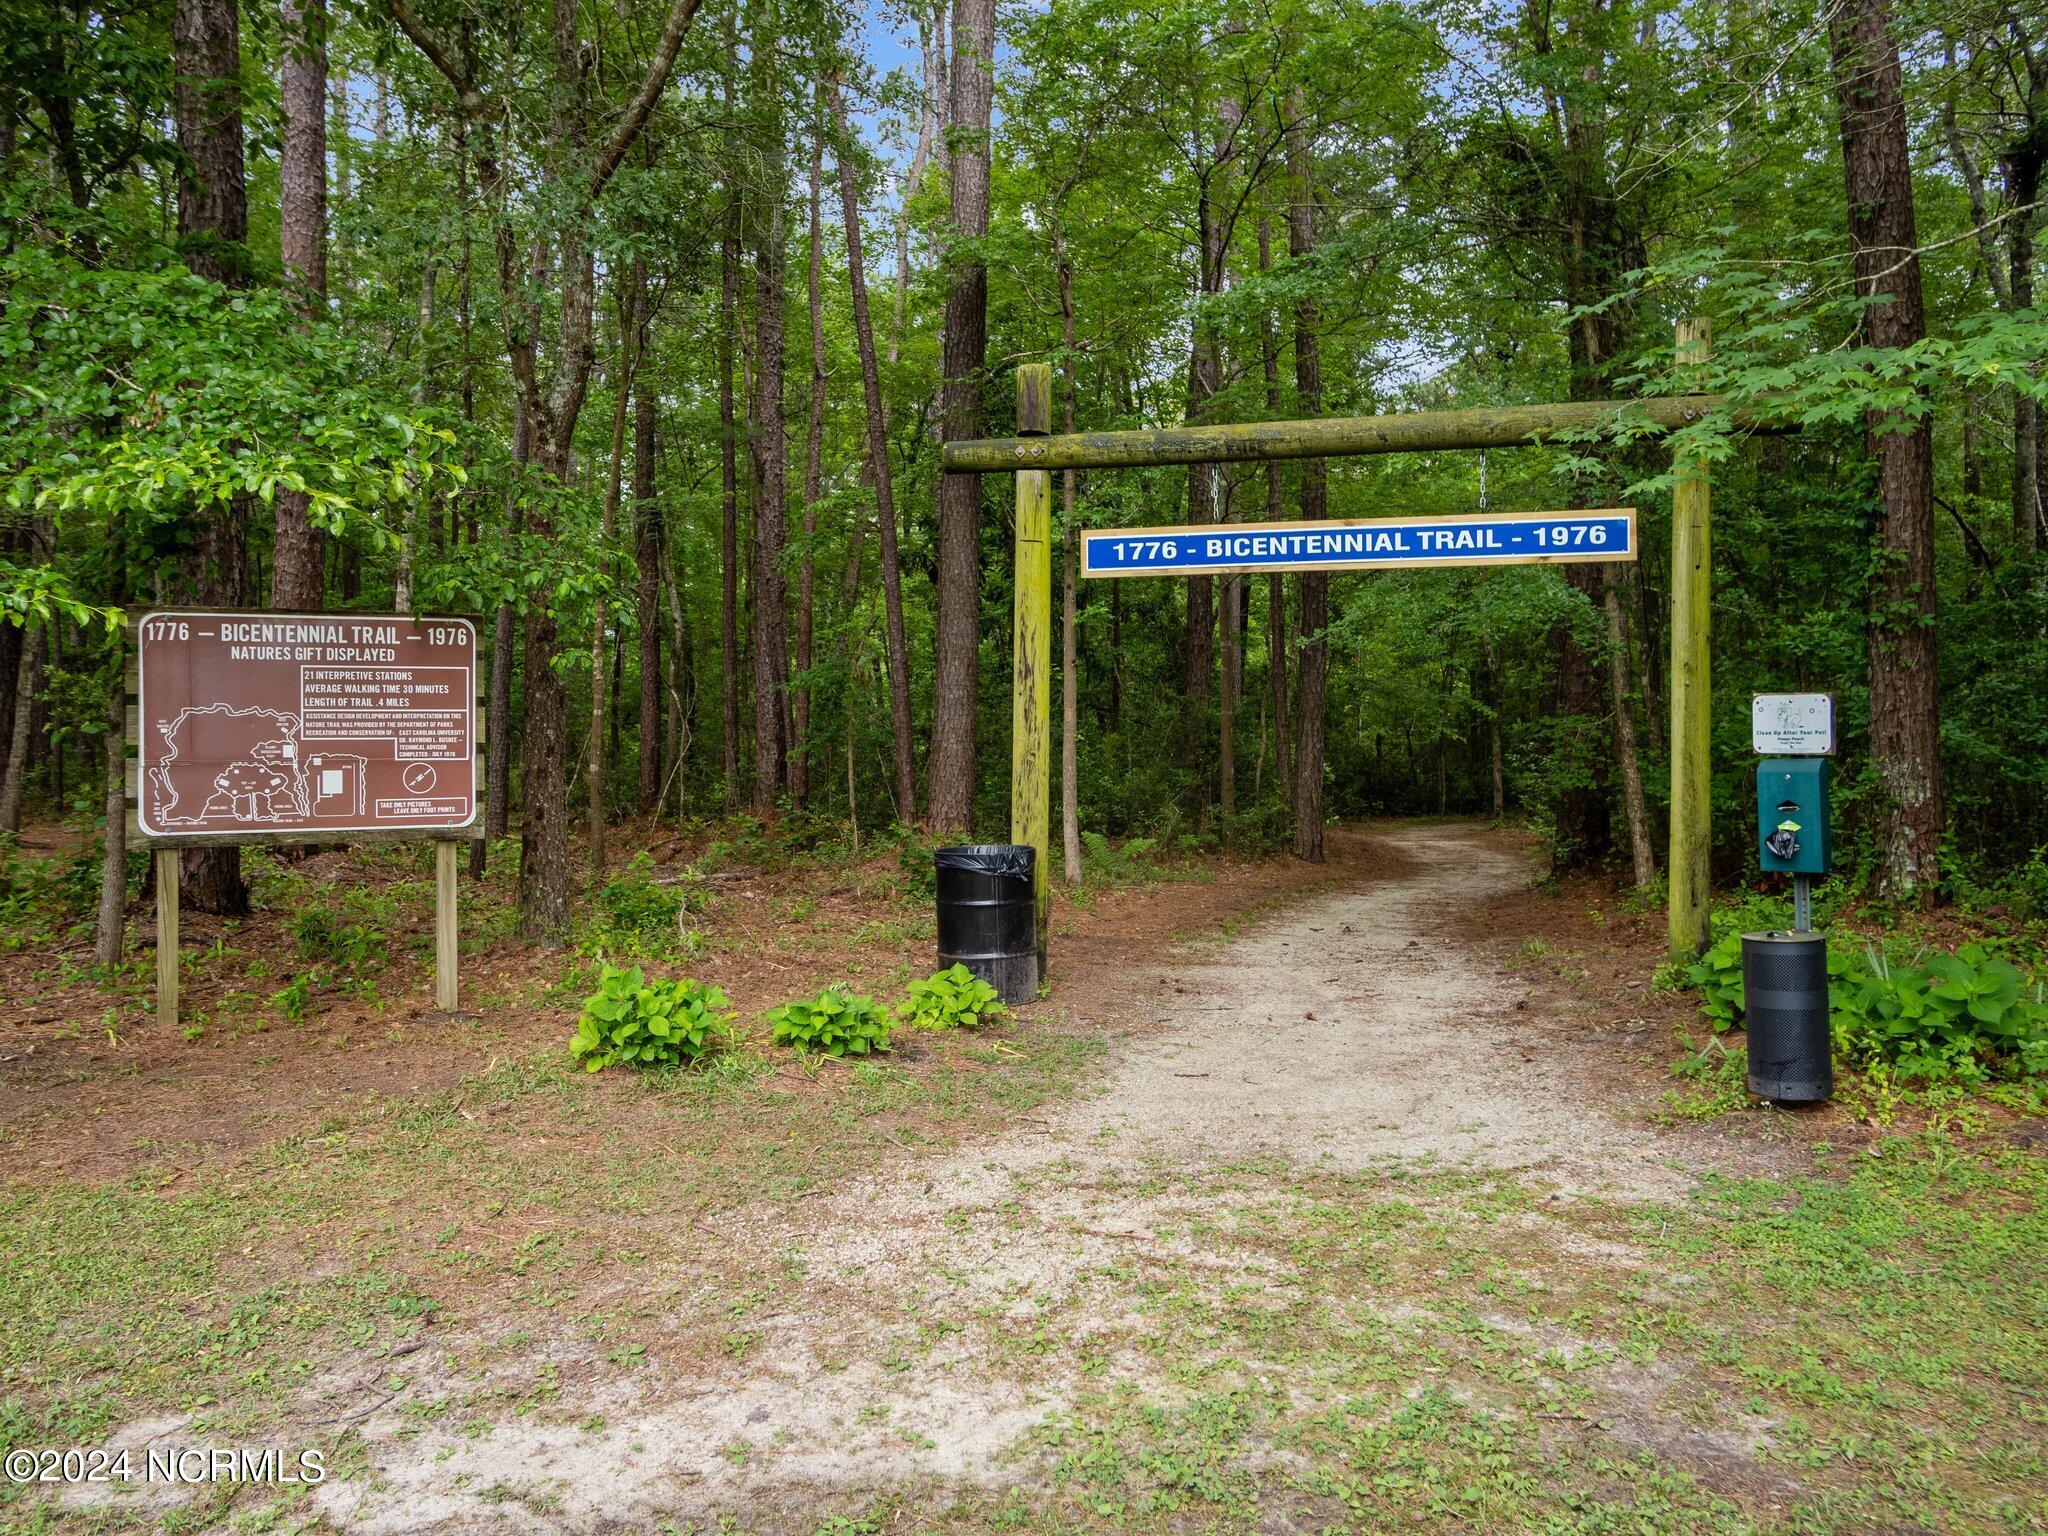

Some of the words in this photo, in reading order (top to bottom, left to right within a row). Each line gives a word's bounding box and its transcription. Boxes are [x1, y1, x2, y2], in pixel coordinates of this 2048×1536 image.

[1113, 541, 1177, 561] 1776
[1207, 532, 1410, 557] BICENTENNIAL
[1417, 529, 1502, 550] TRAIL
[1533, 525, 1607, 546] 1976
[147, 622, 189, 641] 1776
[221, 623, 347, 644] BICENTENNIAL
[351, 626, 400, 645] TRAIL
[427, 627, 467, 645] 1976
[231, 646, 292, 661] NATURES
[295, 647, 322, 661] GIFT
[326, 648, 395, 662] DISPLAYED
[304, 670, 314, 680] 21
[316, 670, 374, 680] INTERPRETIVE
[375, 671, 413, 680] STATIONS
[305, 684, 342, 693] AVERAGE
[344, 684, 380, 693] WALKING
[382, 684, 400, 693] TIME
[403, 684, 413, 694] 30
[415, 685, 449, 694] MINUTES
[304, 697, 335, 707] LENGTH
[337, 697, 348, 707] OF
[350, 697, 373, 707] TRAIL
[375, 698, 384, 707] .4
[386, 698, 410, 707] MILES
